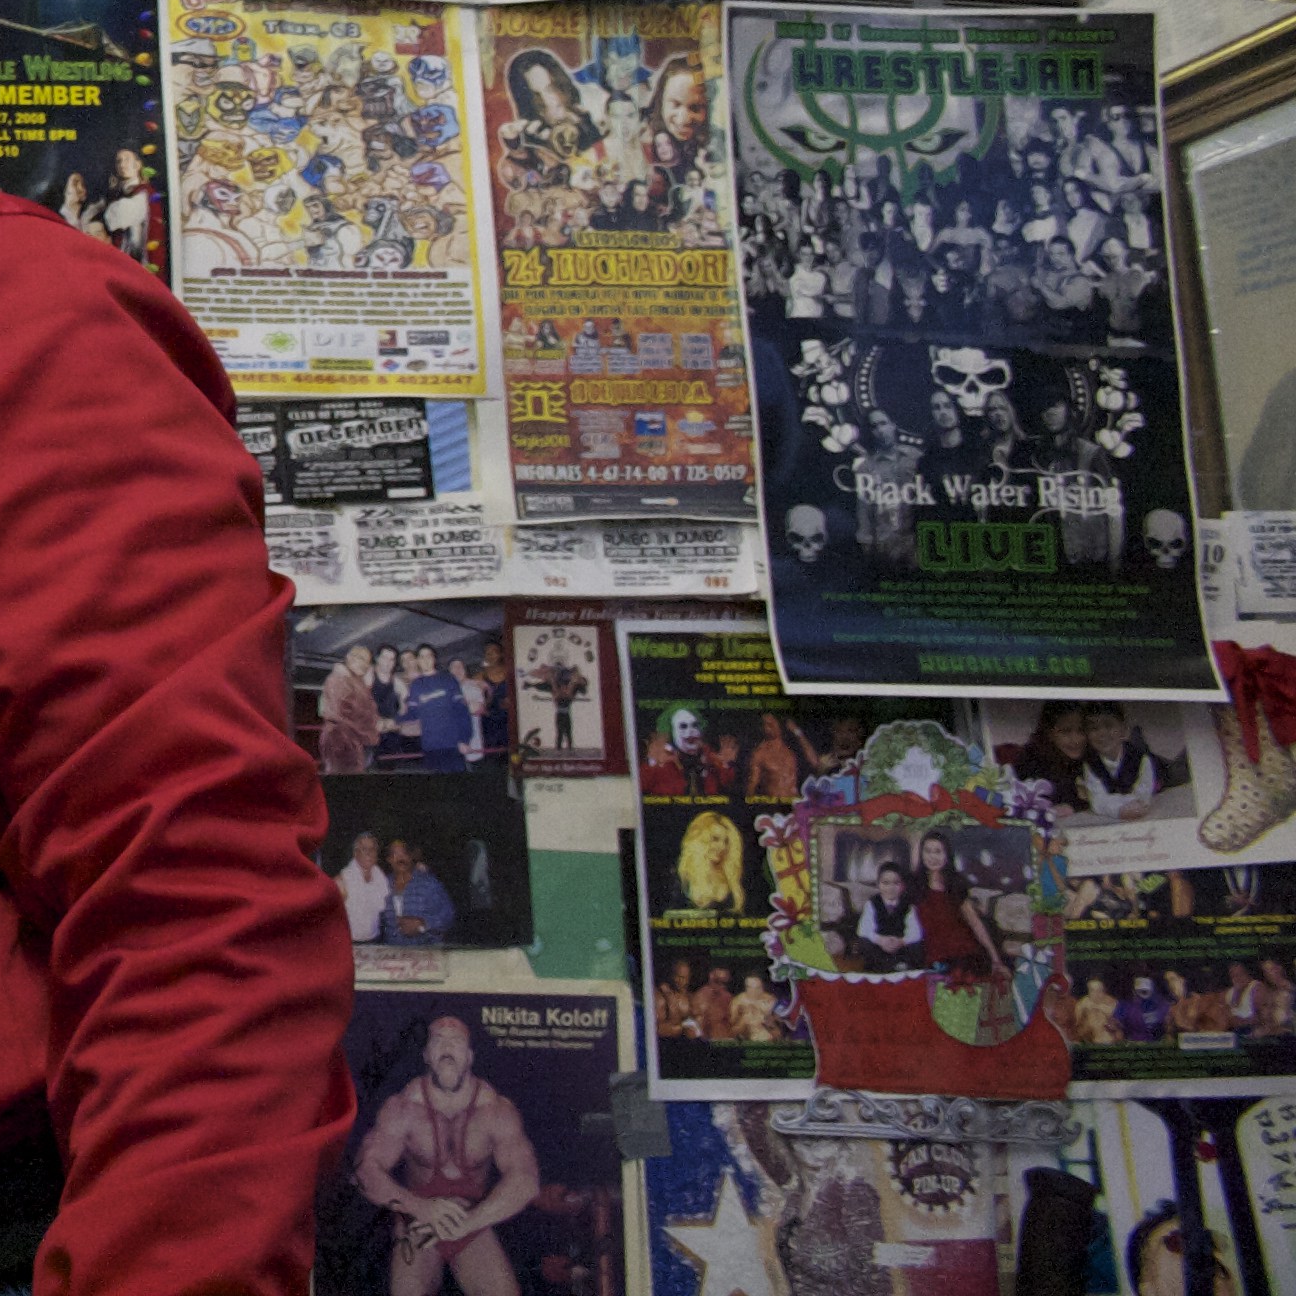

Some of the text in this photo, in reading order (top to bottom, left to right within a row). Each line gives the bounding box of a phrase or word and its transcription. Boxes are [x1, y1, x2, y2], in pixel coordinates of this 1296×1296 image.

[792, 46, 1106, 100] WRESTLEJAM
[549, 249, 727, 286] LUCHADOR
[856, 472, 1122, 516] Black Water Rising
[916, 520, 1059, 574] LIVE
[481, 1006, 608, 1028] Nikita Koloff
